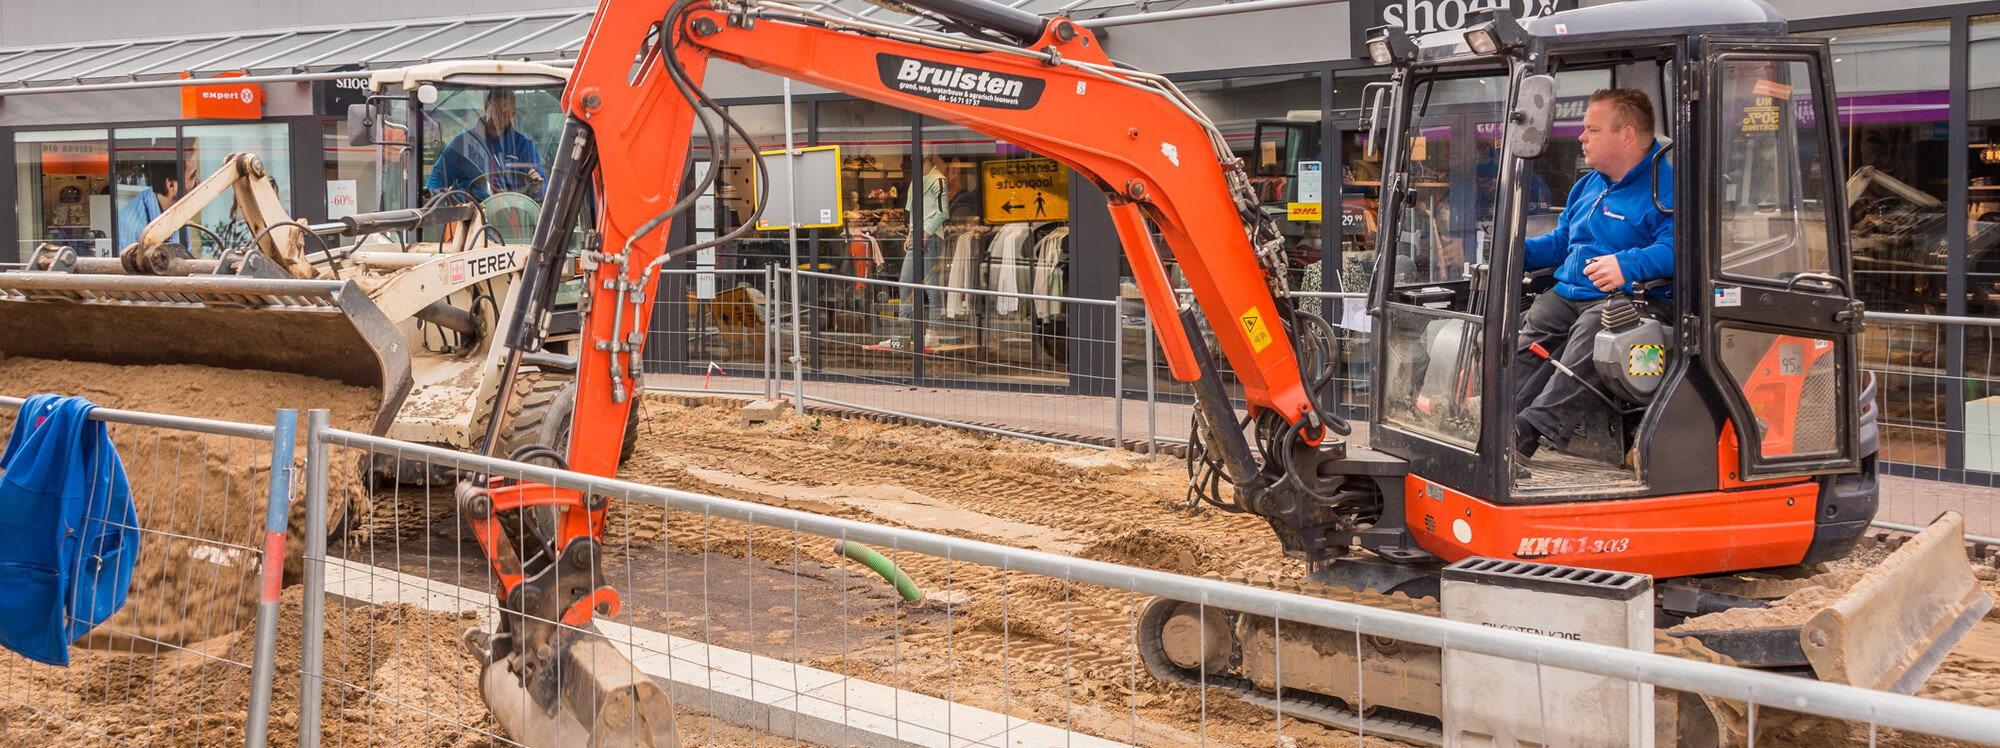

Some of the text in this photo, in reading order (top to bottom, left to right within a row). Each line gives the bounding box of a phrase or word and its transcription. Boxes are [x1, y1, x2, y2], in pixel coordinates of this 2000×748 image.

[1383, 0, 1557, 35] sho
[336, 77, 371, 90] shoe
[897, 59, 1023, 97] Bruisten
[202, 91, 239, 100] expert
[918, 85, 932, 94] weg,
[932, 87, 964, 97] waterbouw
[969, 92, 994, 102] agrarisch
[994, 95, 1019, 105] loonwerk
[62, 145, 93, 153] ADVIES
[330, 194, 355, 207] -60%
[1292, 207, 1318, 215] DHL
[1341, 214, 1363, 226] 29.99
[467, 250, 517, 278] TEREX
[1781, 357, 1797, 373] 95
